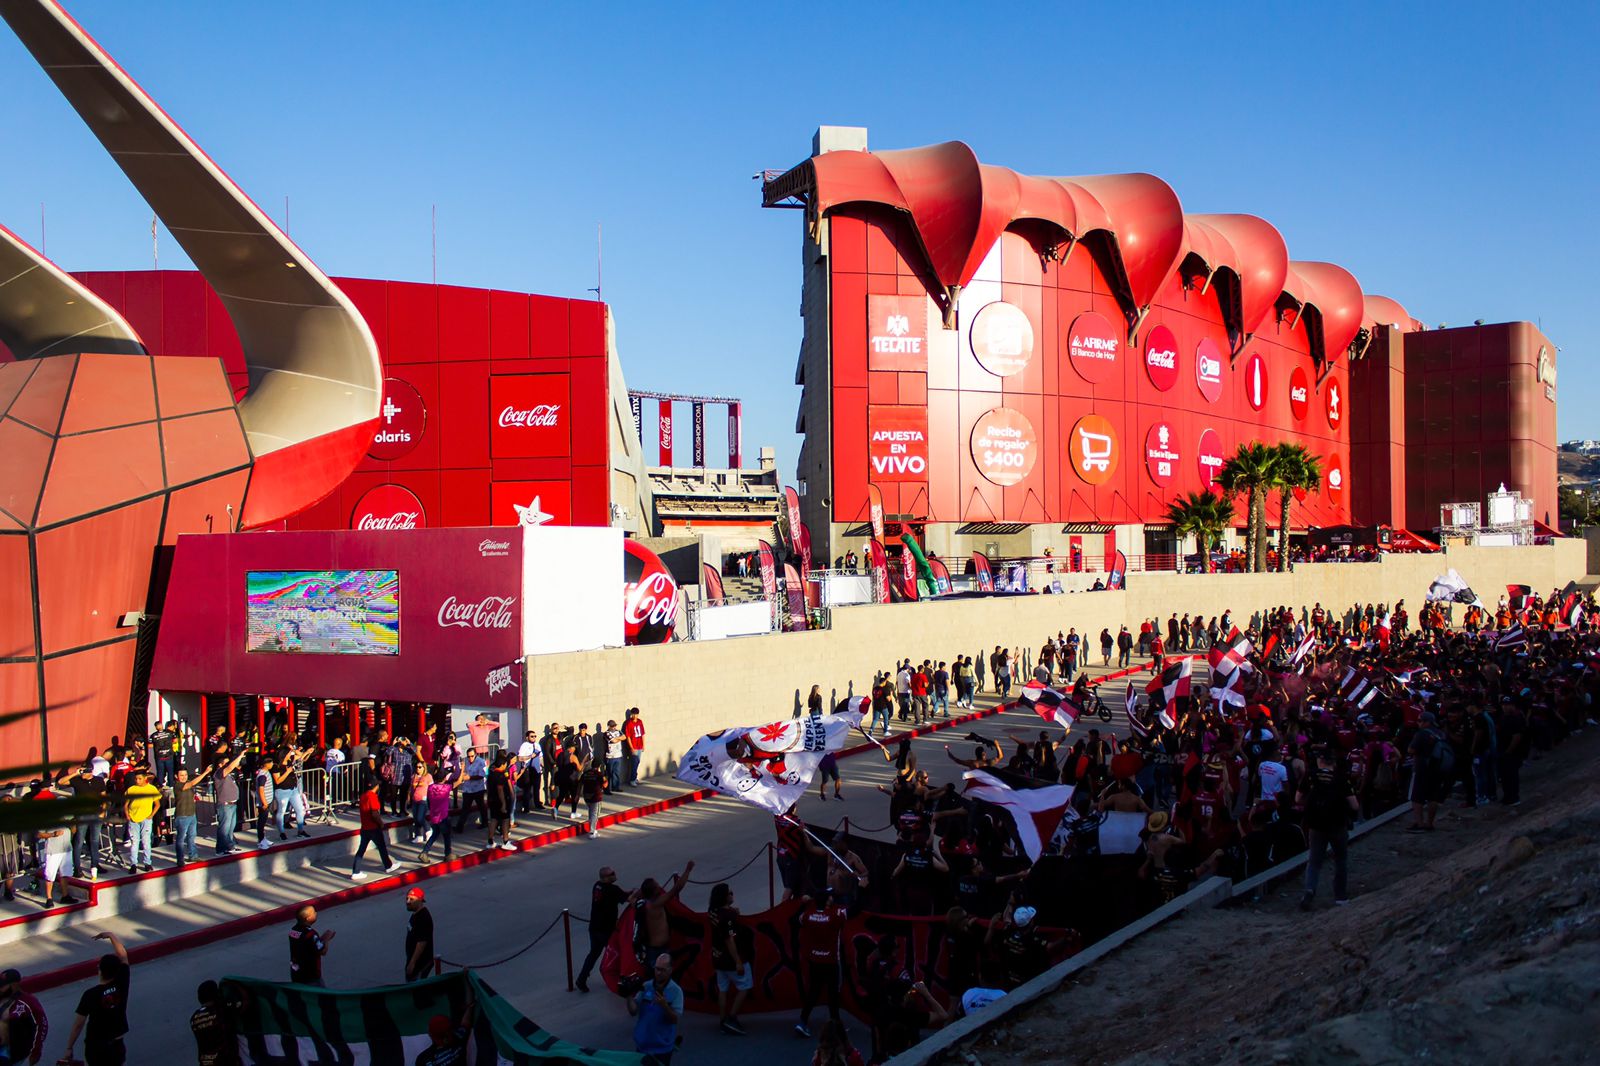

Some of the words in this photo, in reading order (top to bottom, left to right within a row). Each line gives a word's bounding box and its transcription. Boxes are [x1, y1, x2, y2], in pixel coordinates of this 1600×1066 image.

[872, 337, 921, 353] TECATE
[1084, 337, 1116, 351] AFIRME
[1078, 348, 1095, 358] Banco
[1096, 350, 1103, 359] de
[1104, 352, 1115, 361] Hoy
[1148, 348, 1176, 368] Coca-Cola
[498, 404, 560, 428] Coca-Cola
[374, 430, 411, 443] olaris
[660, 416, 671, 449] Coca-Cola
[872, 431, 923, 441] APUESTA
[987, 426, 1022, 438] Recibe
[890, 444, 907, 454] EN
[978, 437, 992, 448] de
[872, 456, 926, 474] VIVO
[984, 450, 1024, 467] $400
[358, 512, 418, 530] Coca-Cola
[479, 539, 510, 551] Caliente
[438, 596, 517, 628] Coca-Cola
[634, 725, 641, 738] 11
[804, 718, 814, 750] IEMPRE
